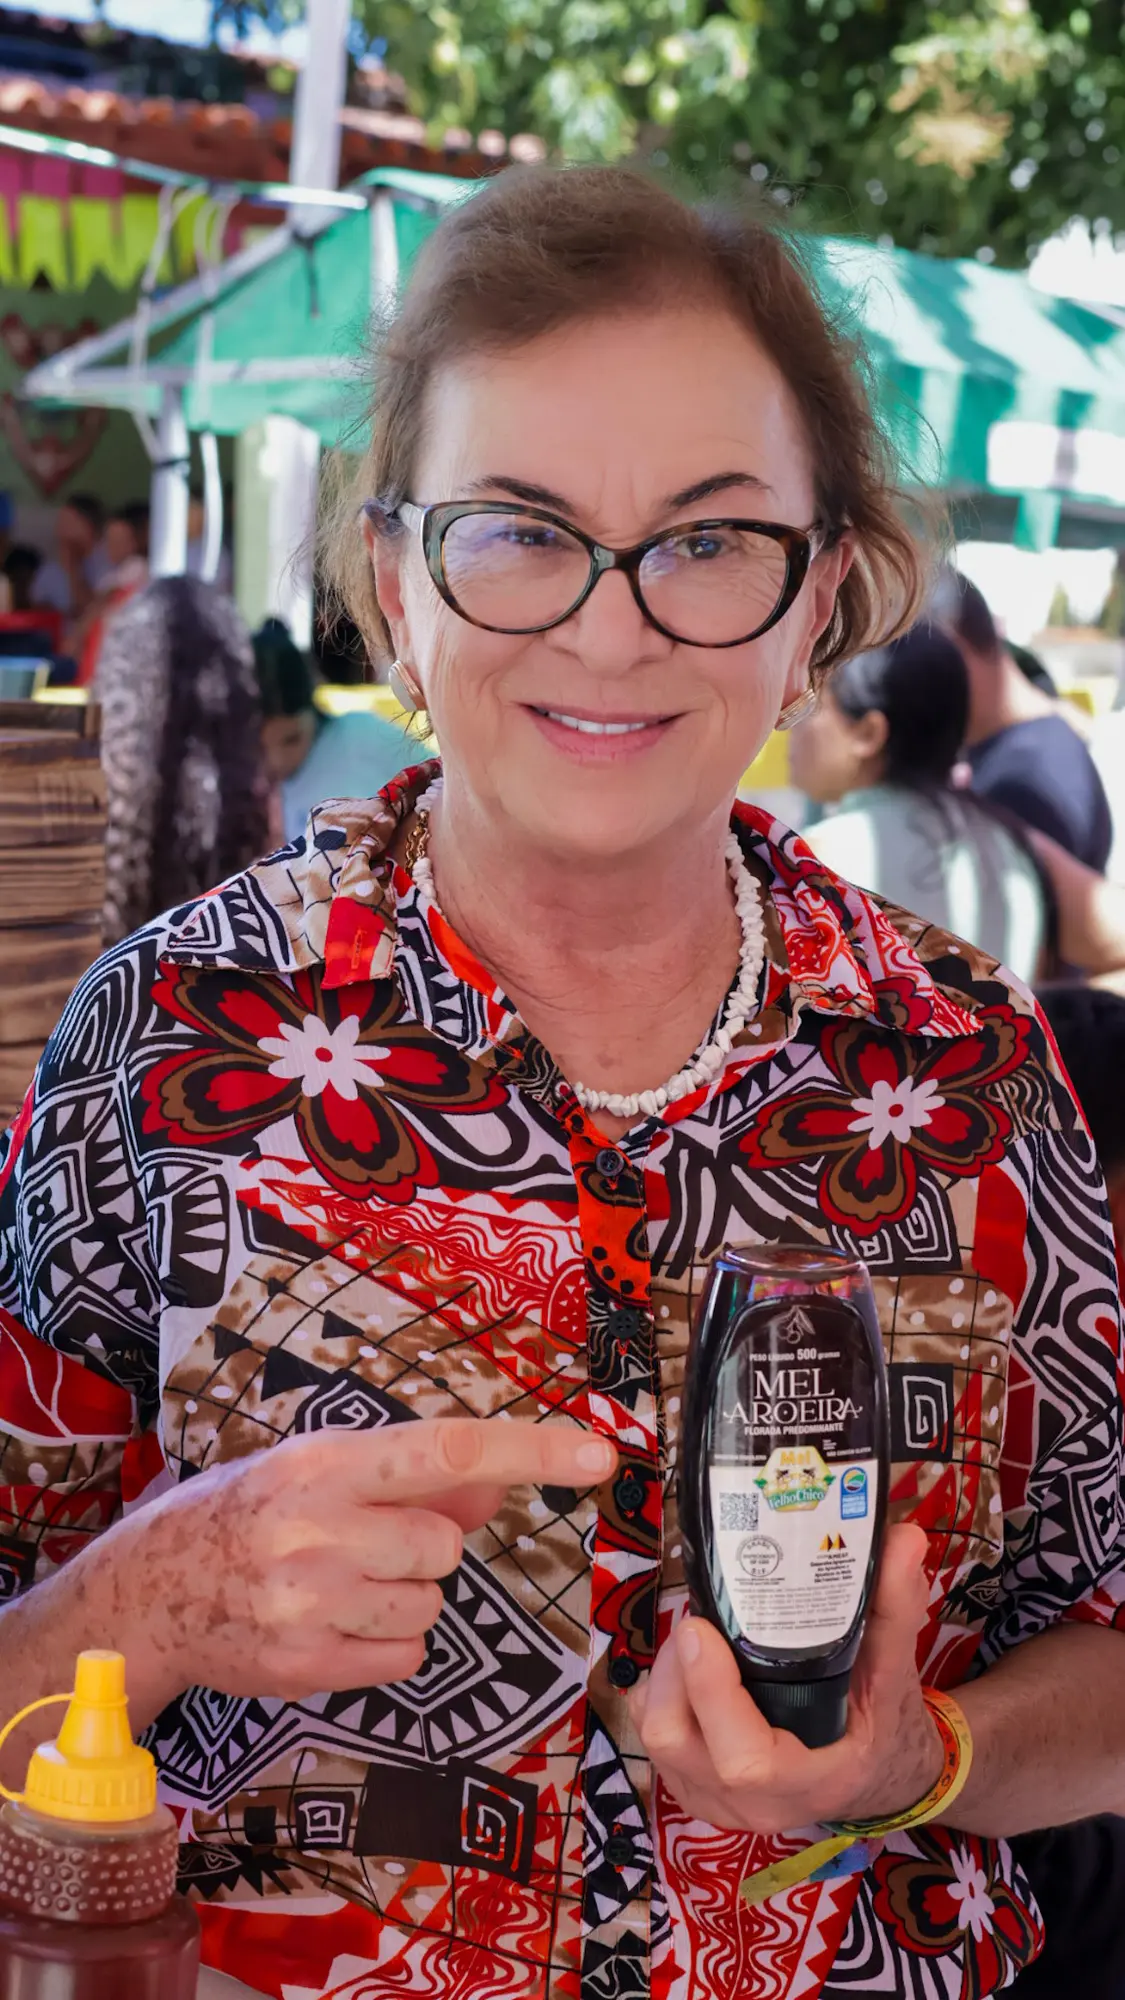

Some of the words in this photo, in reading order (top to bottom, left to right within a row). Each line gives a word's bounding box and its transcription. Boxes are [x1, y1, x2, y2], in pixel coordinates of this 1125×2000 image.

[749, 1353, 767, 1362] PESO
[796, 1348, 817, 1361] 500
[754, 1368, 835, 1399] MEL
[723, 1397, 863, 1424] AROEIRA
[744, 1425, 781, 1436] FLORADA
[783, 1422, 844, 1435] PREDOMINANTE
[780, 1450, 811, 1465] Mel
